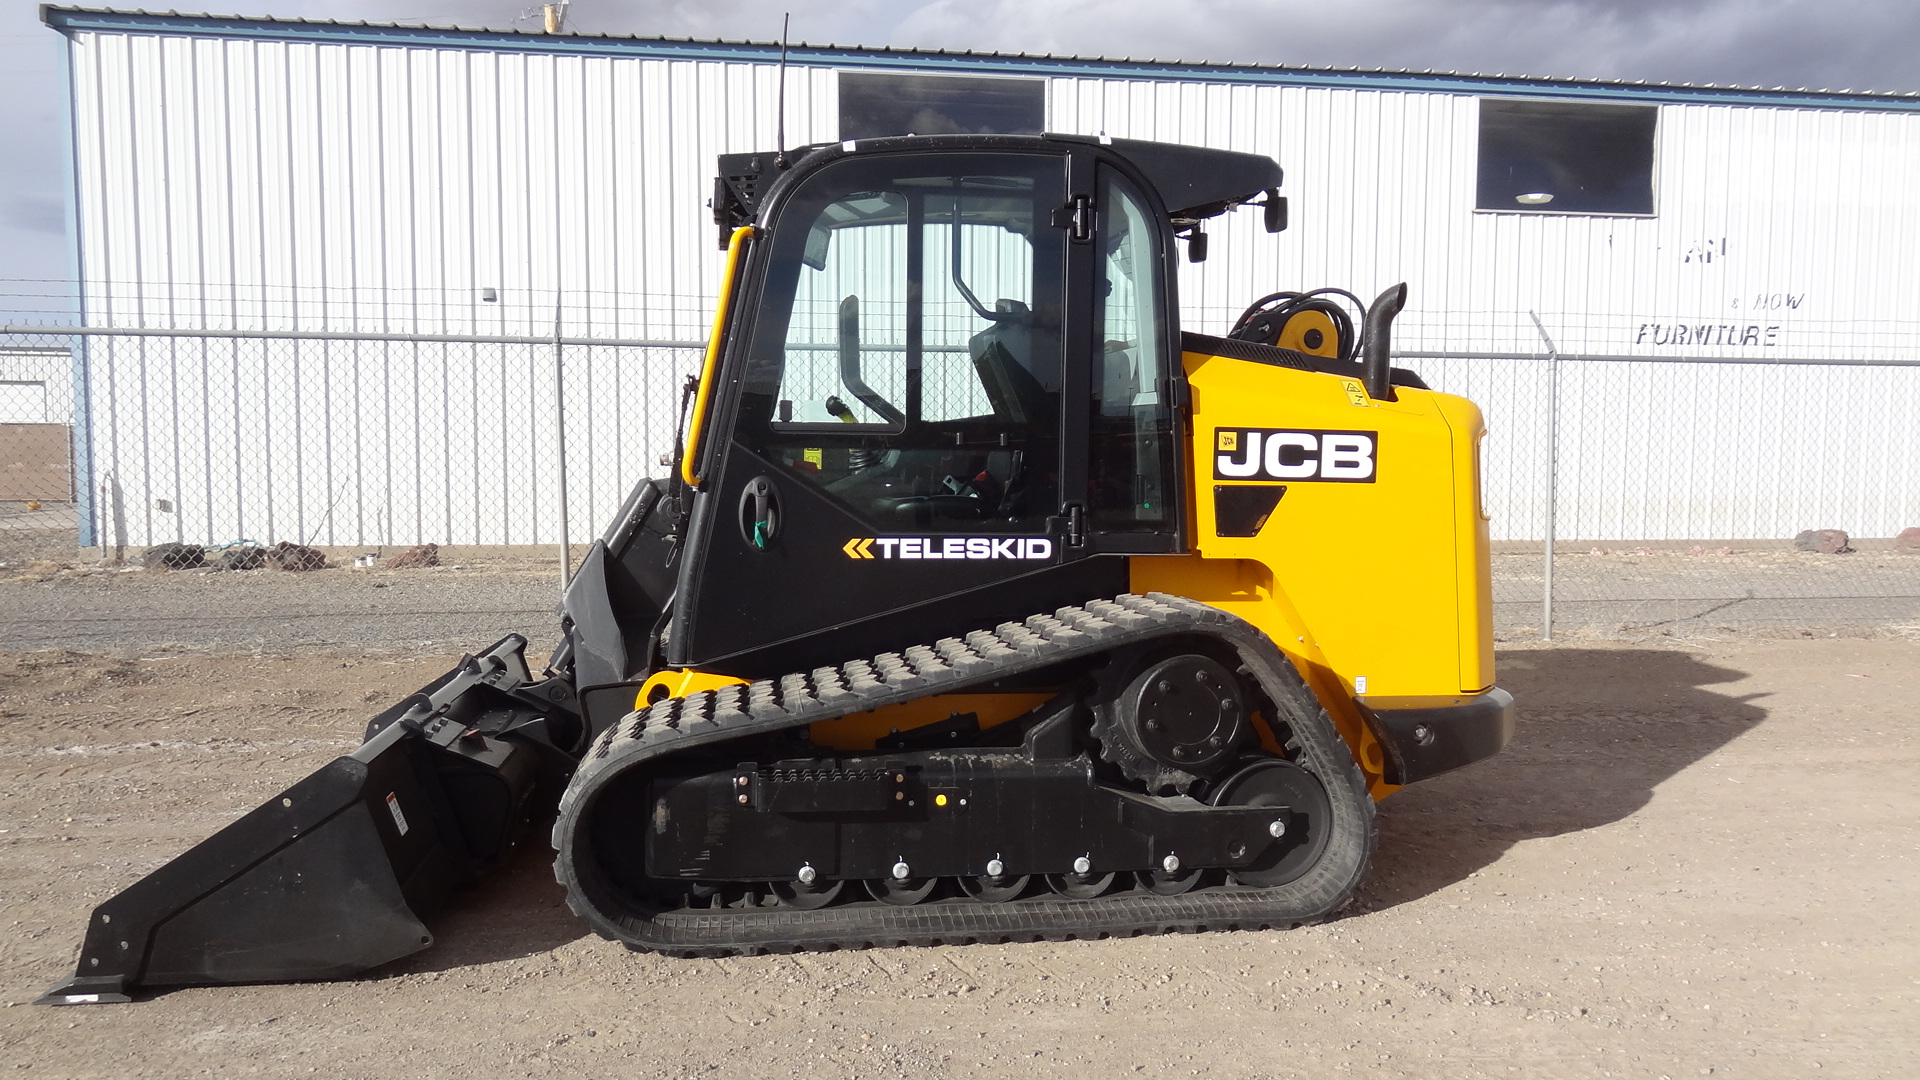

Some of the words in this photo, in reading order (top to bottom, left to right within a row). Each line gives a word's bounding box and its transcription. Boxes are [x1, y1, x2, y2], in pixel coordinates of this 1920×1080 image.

[1636, 323, 1780, 347] FURNITURE
[1217, 432, 1374, 479] JCB
[875, 537, 1052, 560] TELESKID
